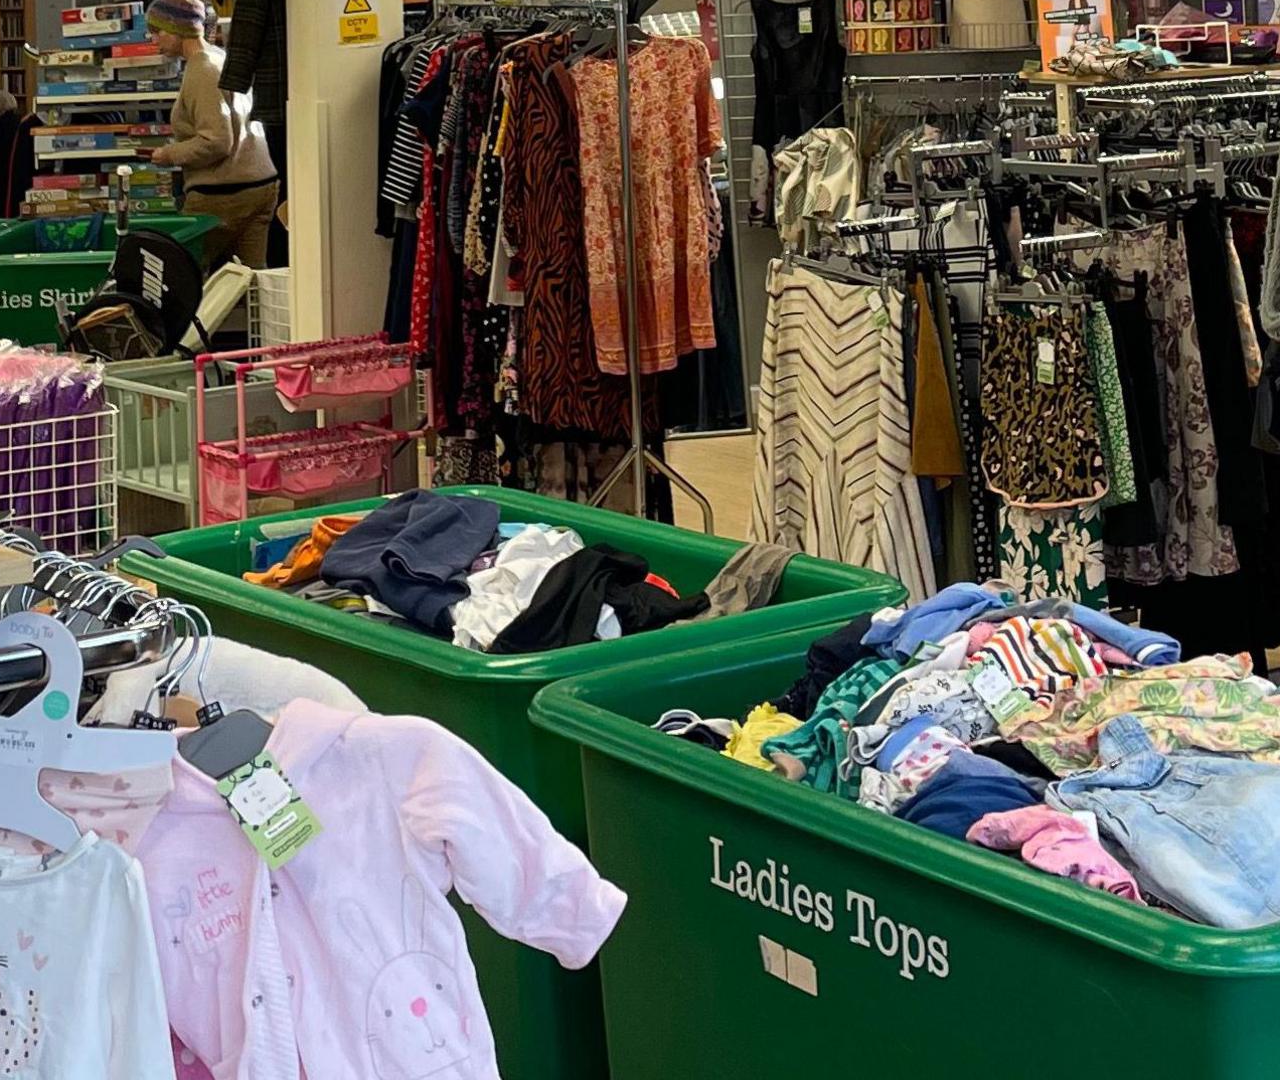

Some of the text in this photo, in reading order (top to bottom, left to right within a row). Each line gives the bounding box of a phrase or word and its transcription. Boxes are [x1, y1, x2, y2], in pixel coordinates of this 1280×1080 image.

[347, 18, 368, 27] CCTV
[708, 836, 951, 981] Ladies Tops
